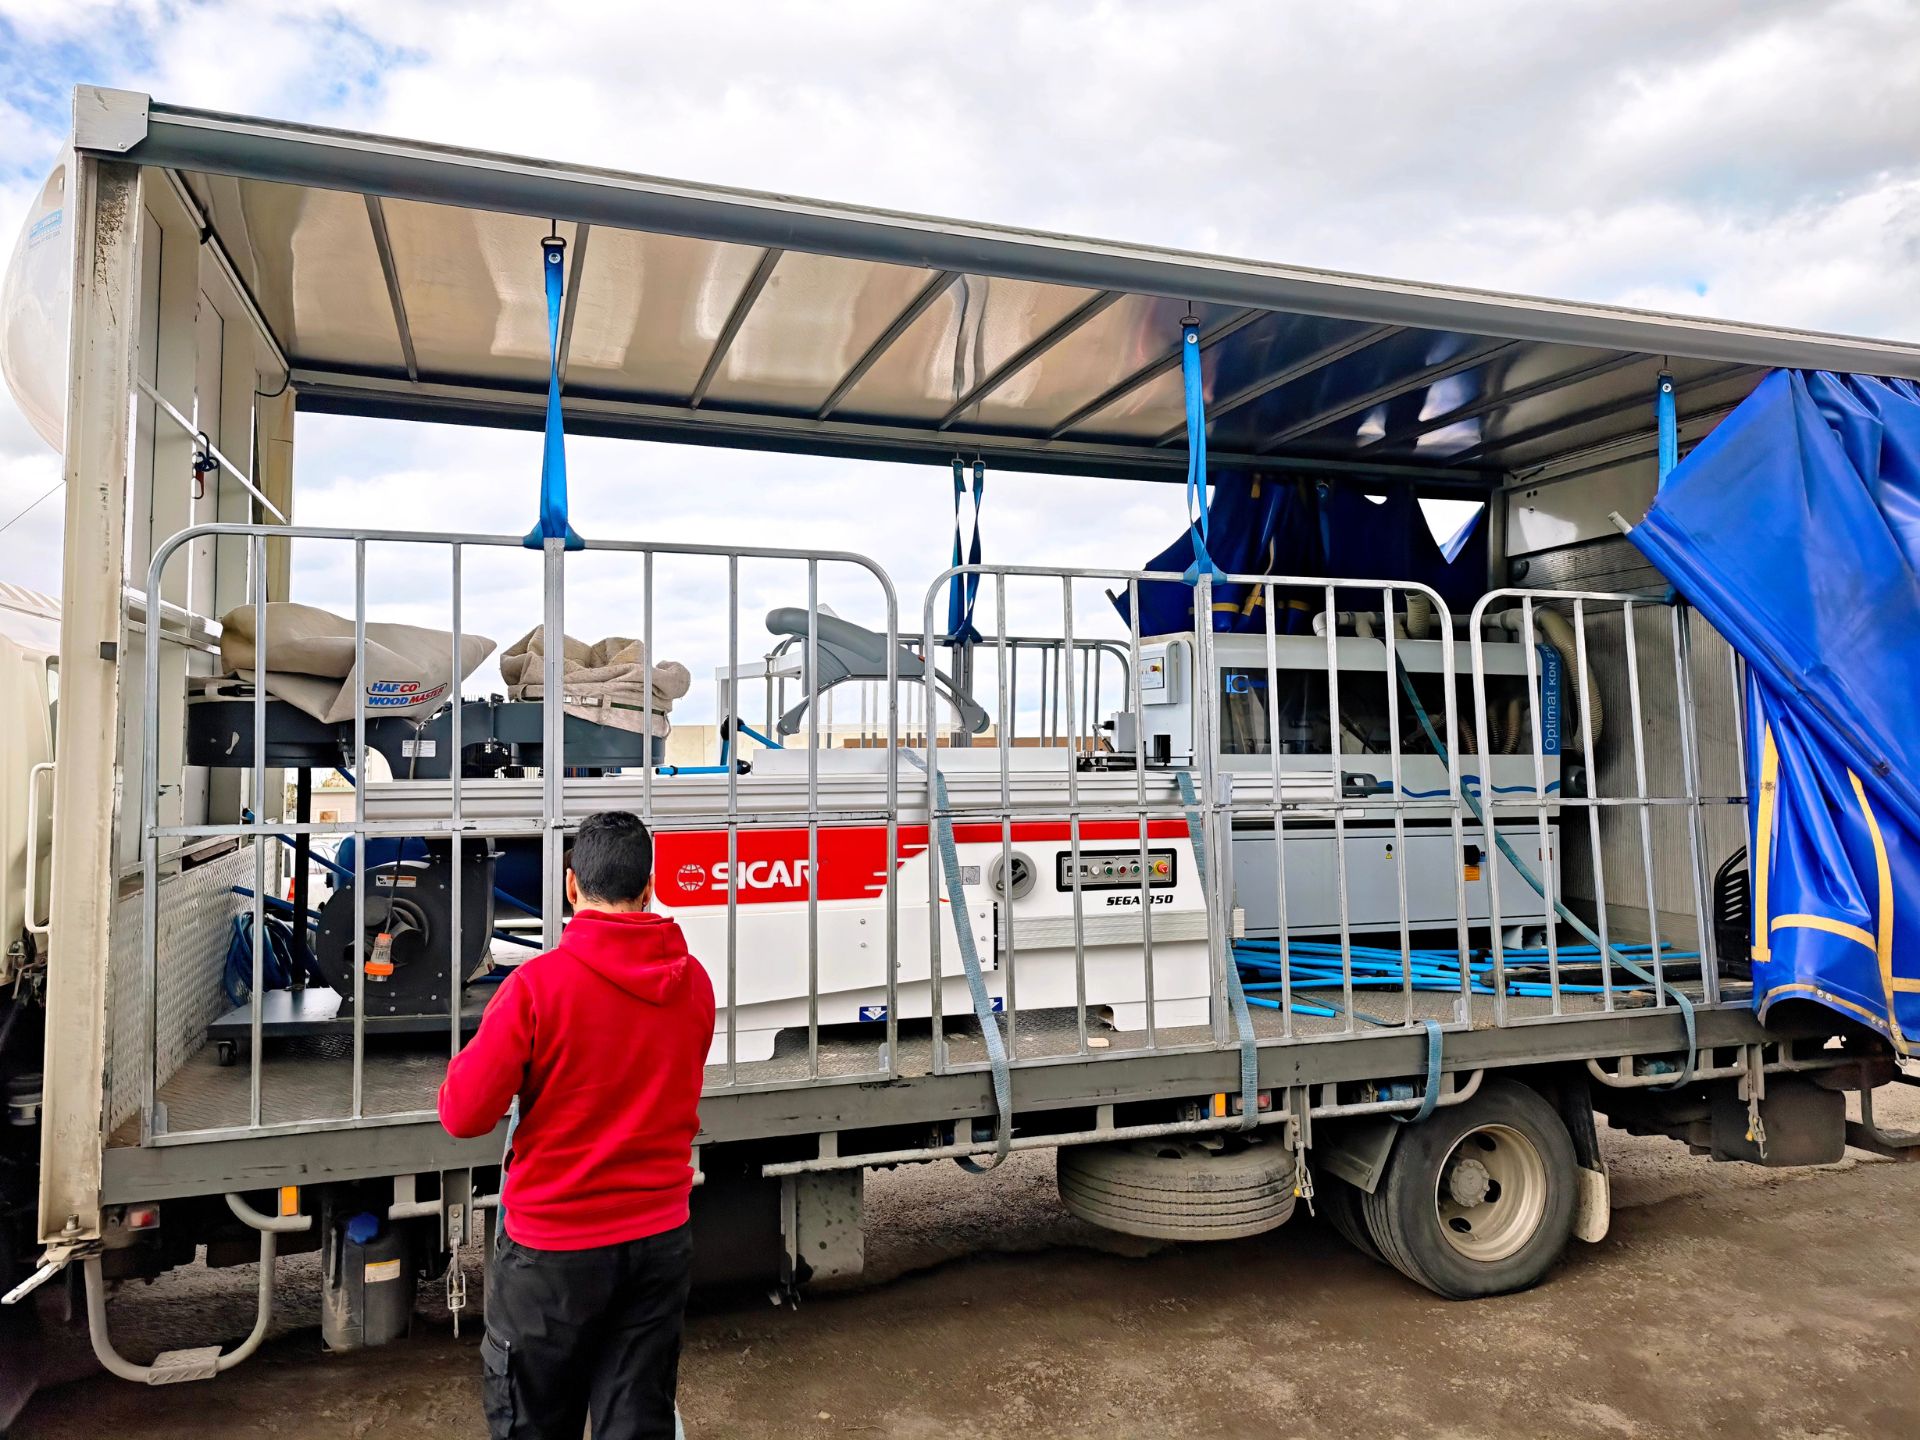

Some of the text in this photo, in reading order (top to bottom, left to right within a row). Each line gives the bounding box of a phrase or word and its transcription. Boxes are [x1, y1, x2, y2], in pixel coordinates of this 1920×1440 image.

[1548, 661, 1557, 686] KDN
[371, 682, 418, 693] HAFCO
[1544, 690, 1559, 751] Optimat
[711, 859, 820, 891] SICAR
[1106, 896, 1141, 906] SEGA
